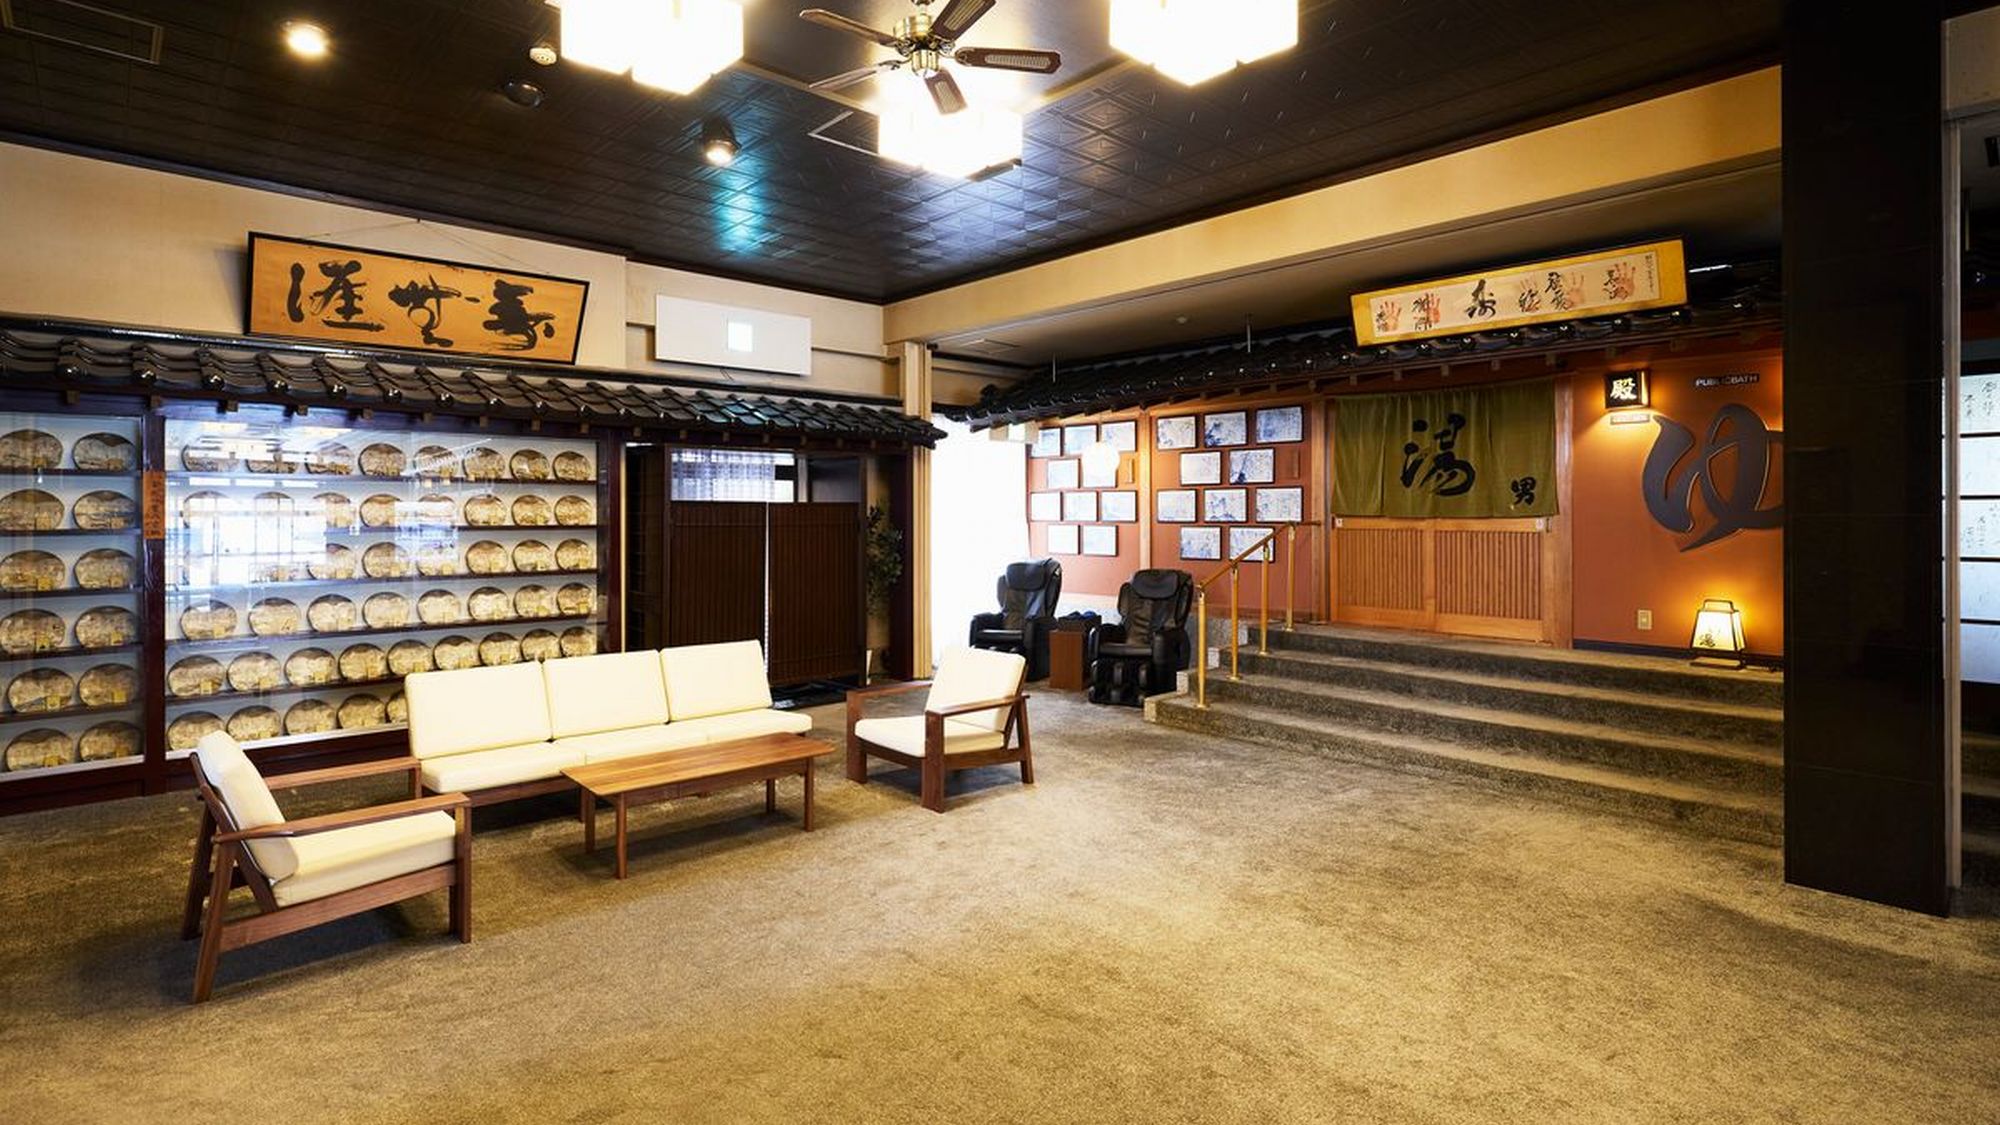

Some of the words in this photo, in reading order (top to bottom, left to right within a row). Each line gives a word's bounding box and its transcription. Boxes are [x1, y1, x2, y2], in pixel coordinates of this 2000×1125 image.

[1610, 377, 1637, 400] 殿
[1400, 412, 1476, 497] 湯
[1641, 402, 1784, 552] ゆ
[1511, 476, 1537, 506] 男
